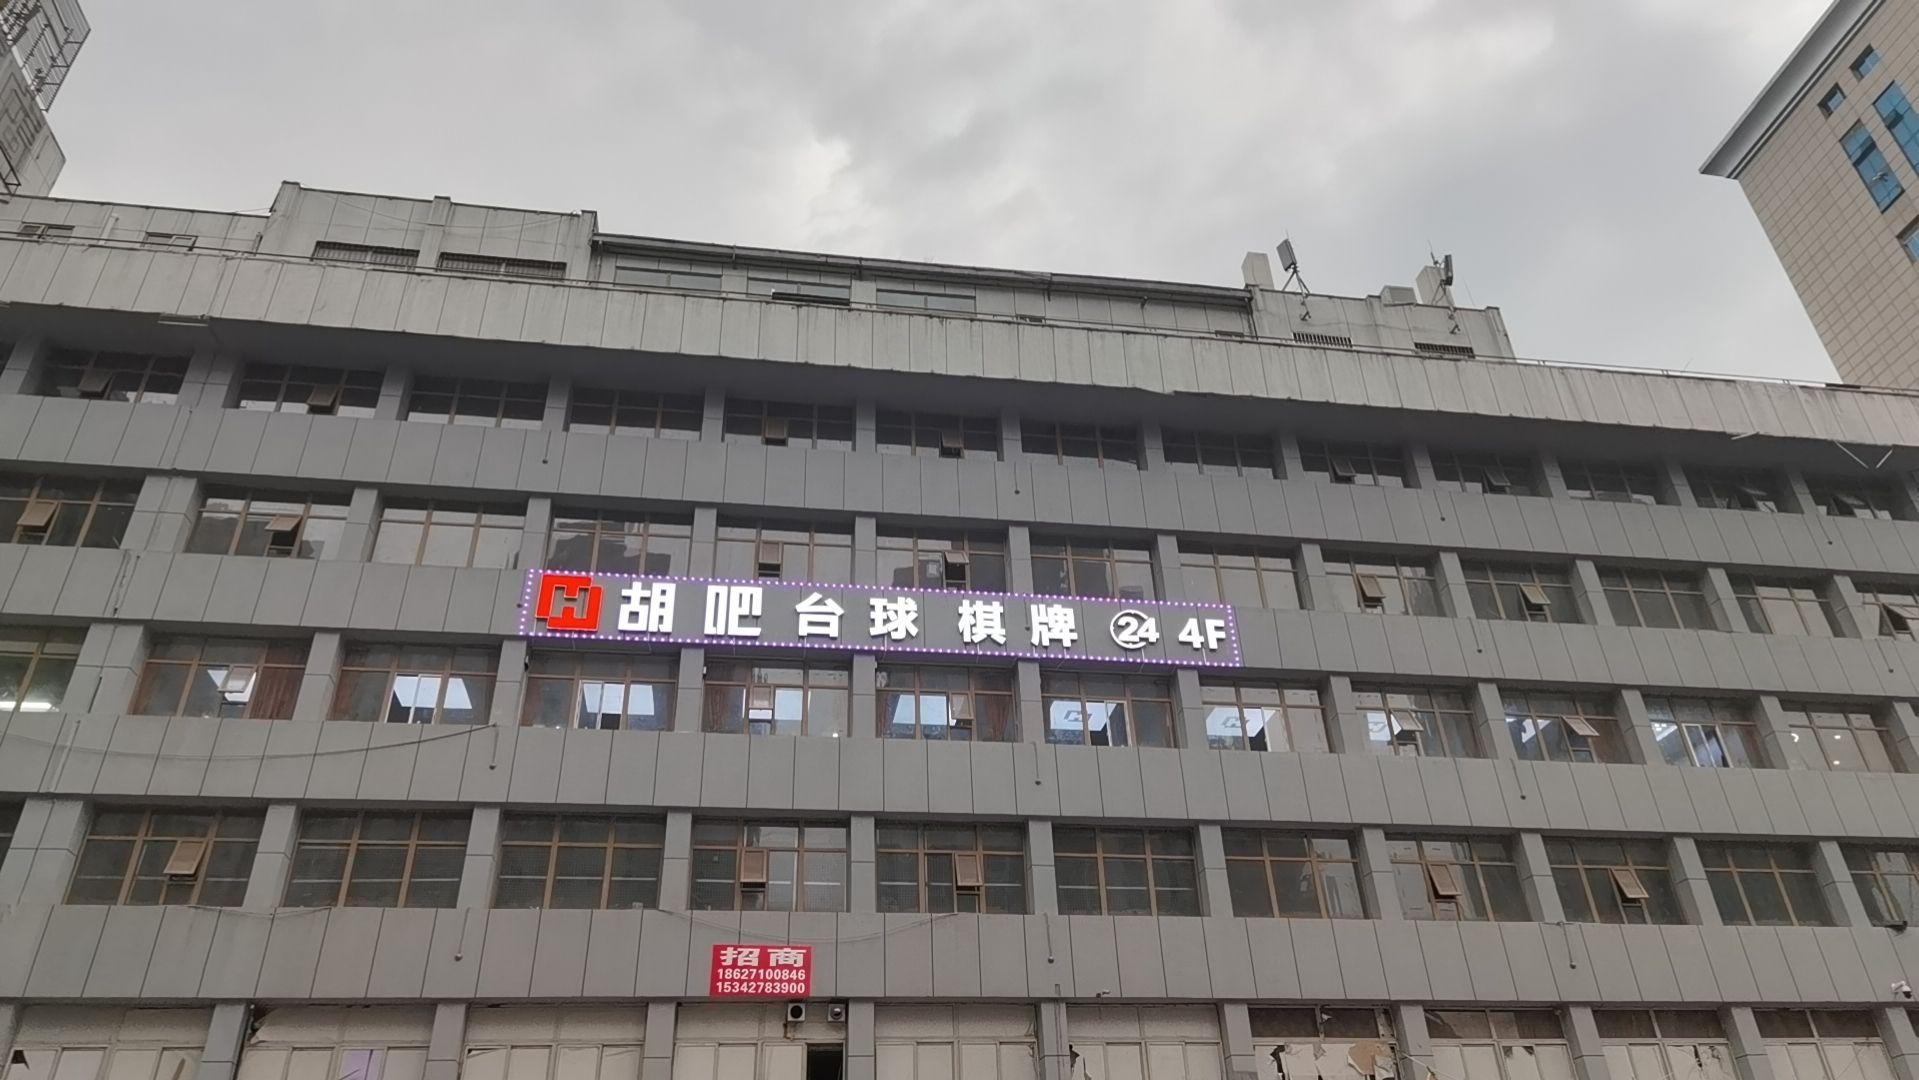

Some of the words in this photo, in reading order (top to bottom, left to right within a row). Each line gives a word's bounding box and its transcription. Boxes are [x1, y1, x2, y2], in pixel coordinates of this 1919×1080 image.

[617, 581, 1078, 648] 胡吧台球棋牌
[1111, 610, 1160, 648] 24
[1178, 617, 1226, 650] 4F
[719, 946, 807, 968] 招商
[717, 968, 806, 980] 18627100846
[716, 981, 806, 994] 15342783900
